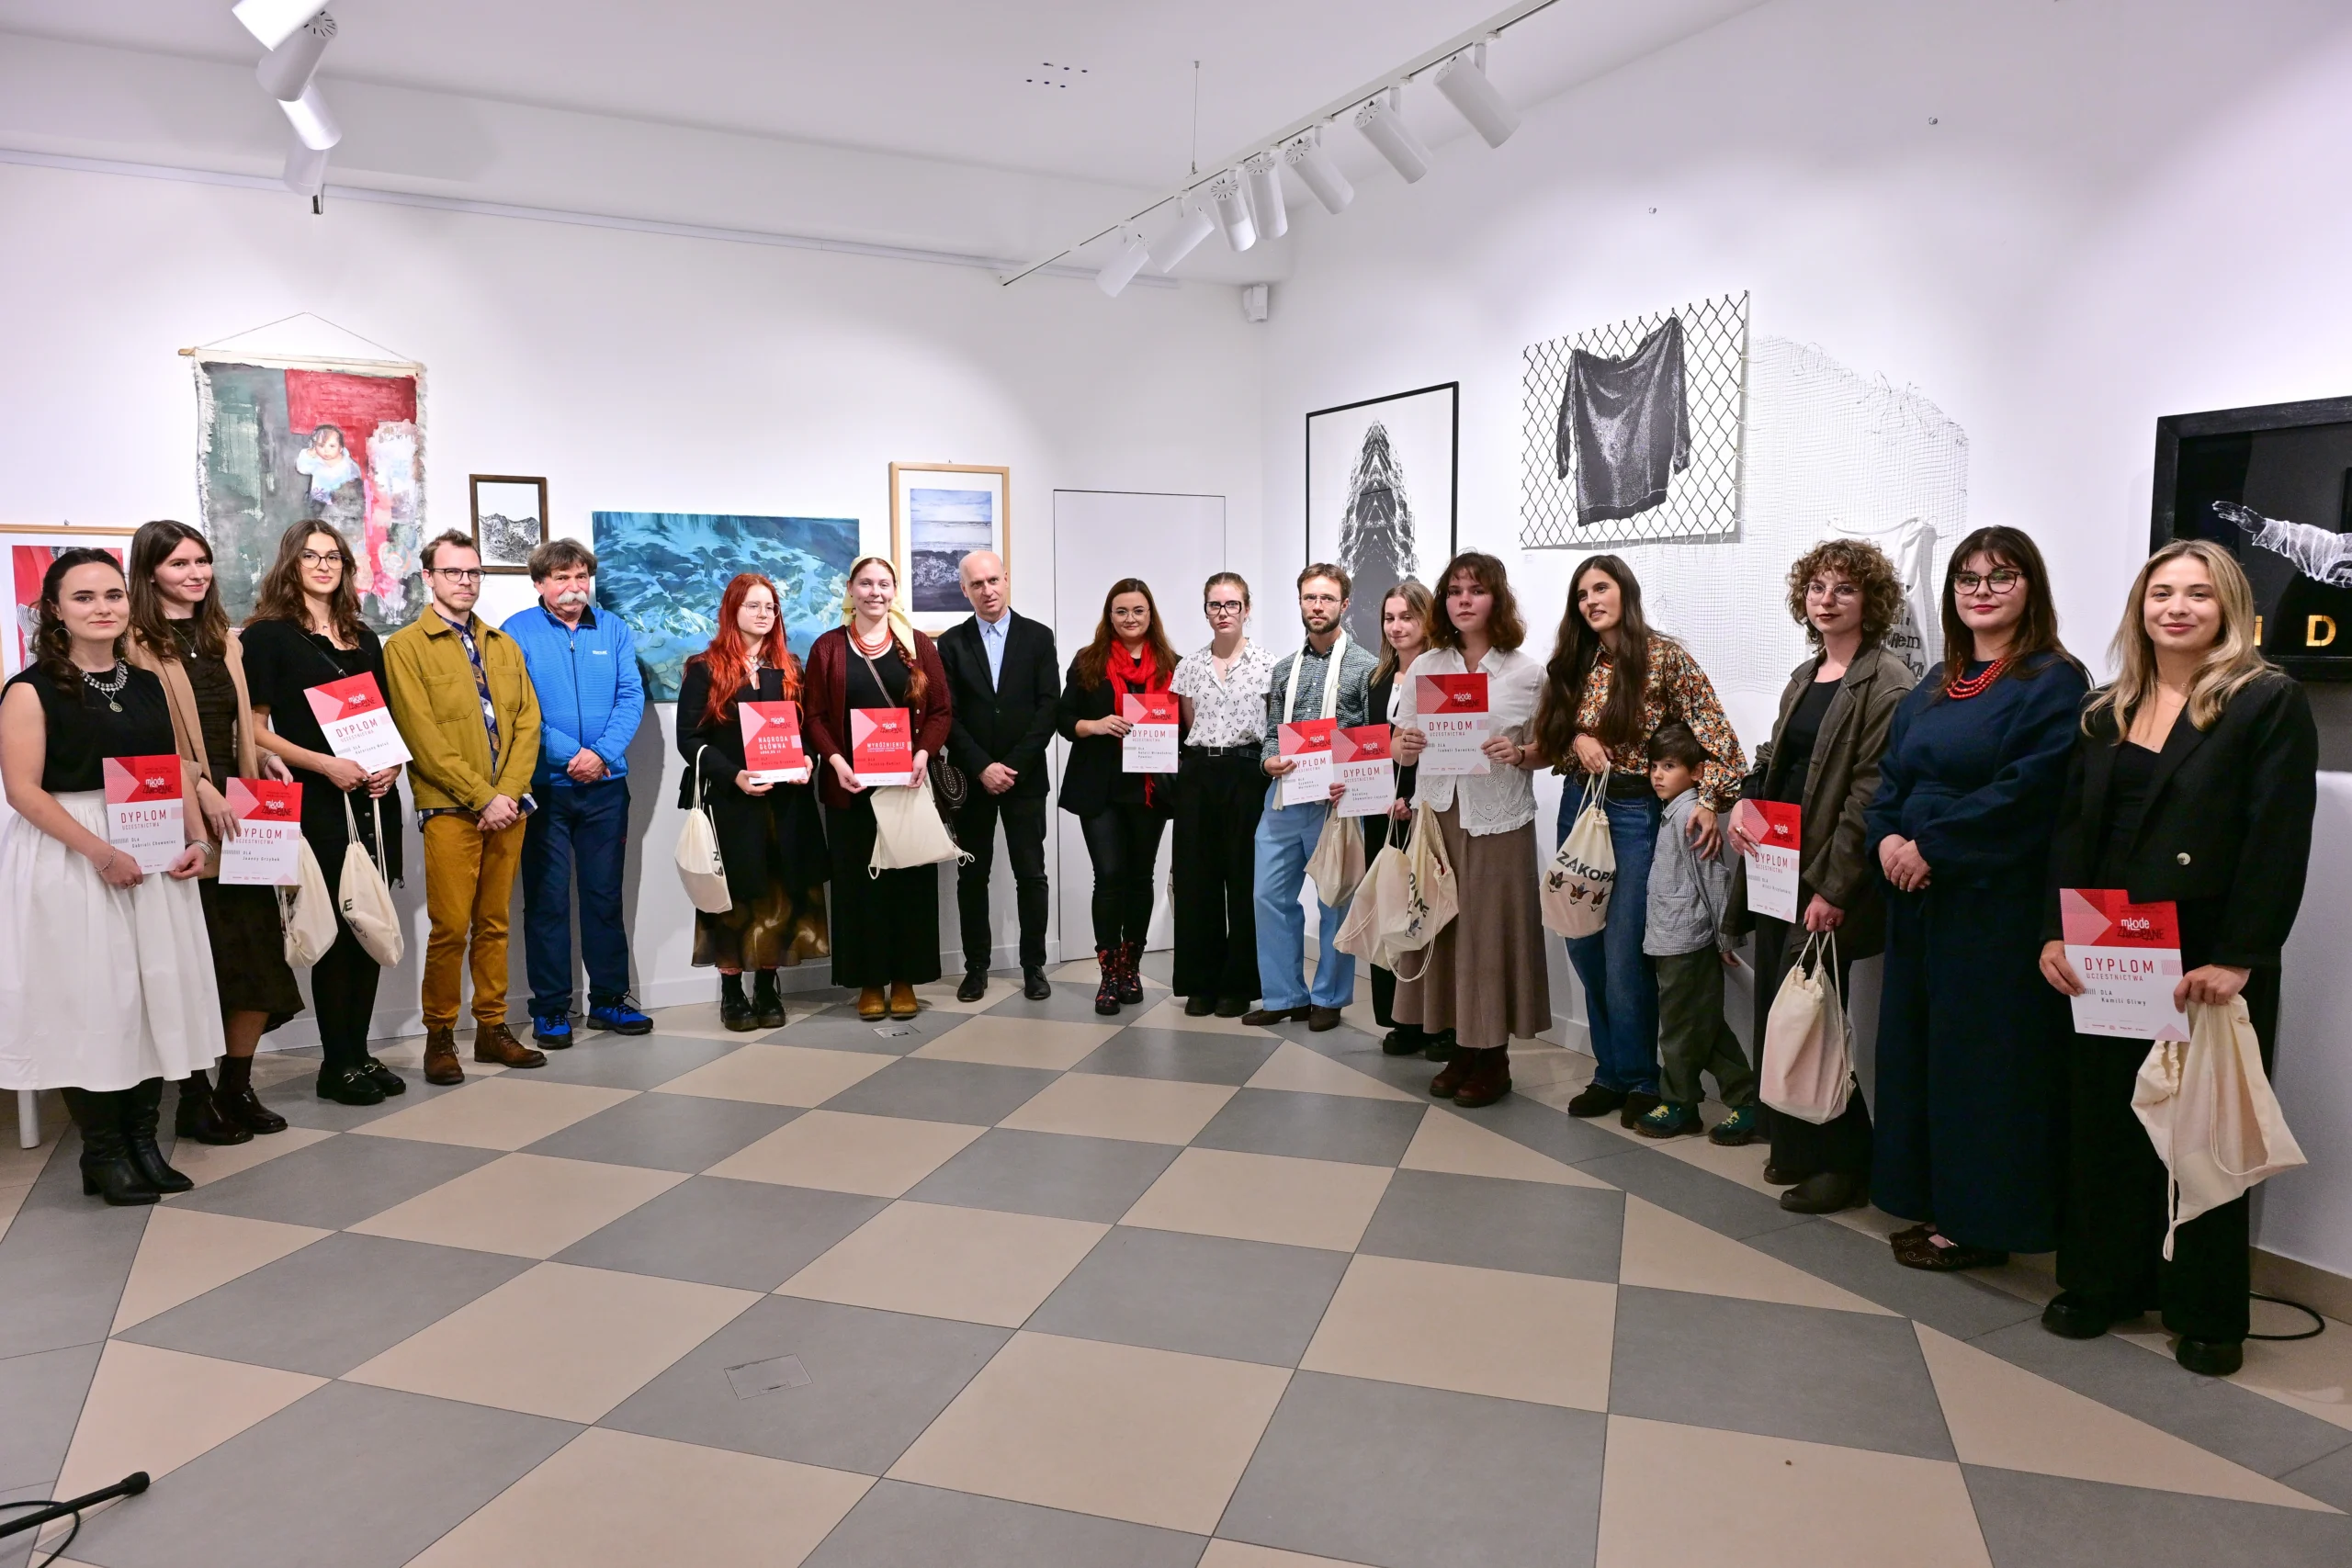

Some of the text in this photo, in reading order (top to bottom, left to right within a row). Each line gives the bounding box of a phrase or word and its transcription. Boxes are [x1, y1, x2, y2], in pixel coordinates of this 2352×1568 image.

[336, 718, 379, 738] DYPLOM
[1430, 720, 1472, 731] DYPLOM
[1132, 729, 1165, 738] DYPLOM
[1295, 757, 1327, 768] YPLOM
[1343, 766, 1380, 777] DYPLOM
[120, 809, 167, 824] DYPLOM
[121, 822, 160, 830] UCZESTNICTWA
[1755, 852, 1788, 868] DYPLOM
[2085, 957, 2154, 974] DYPLOM
